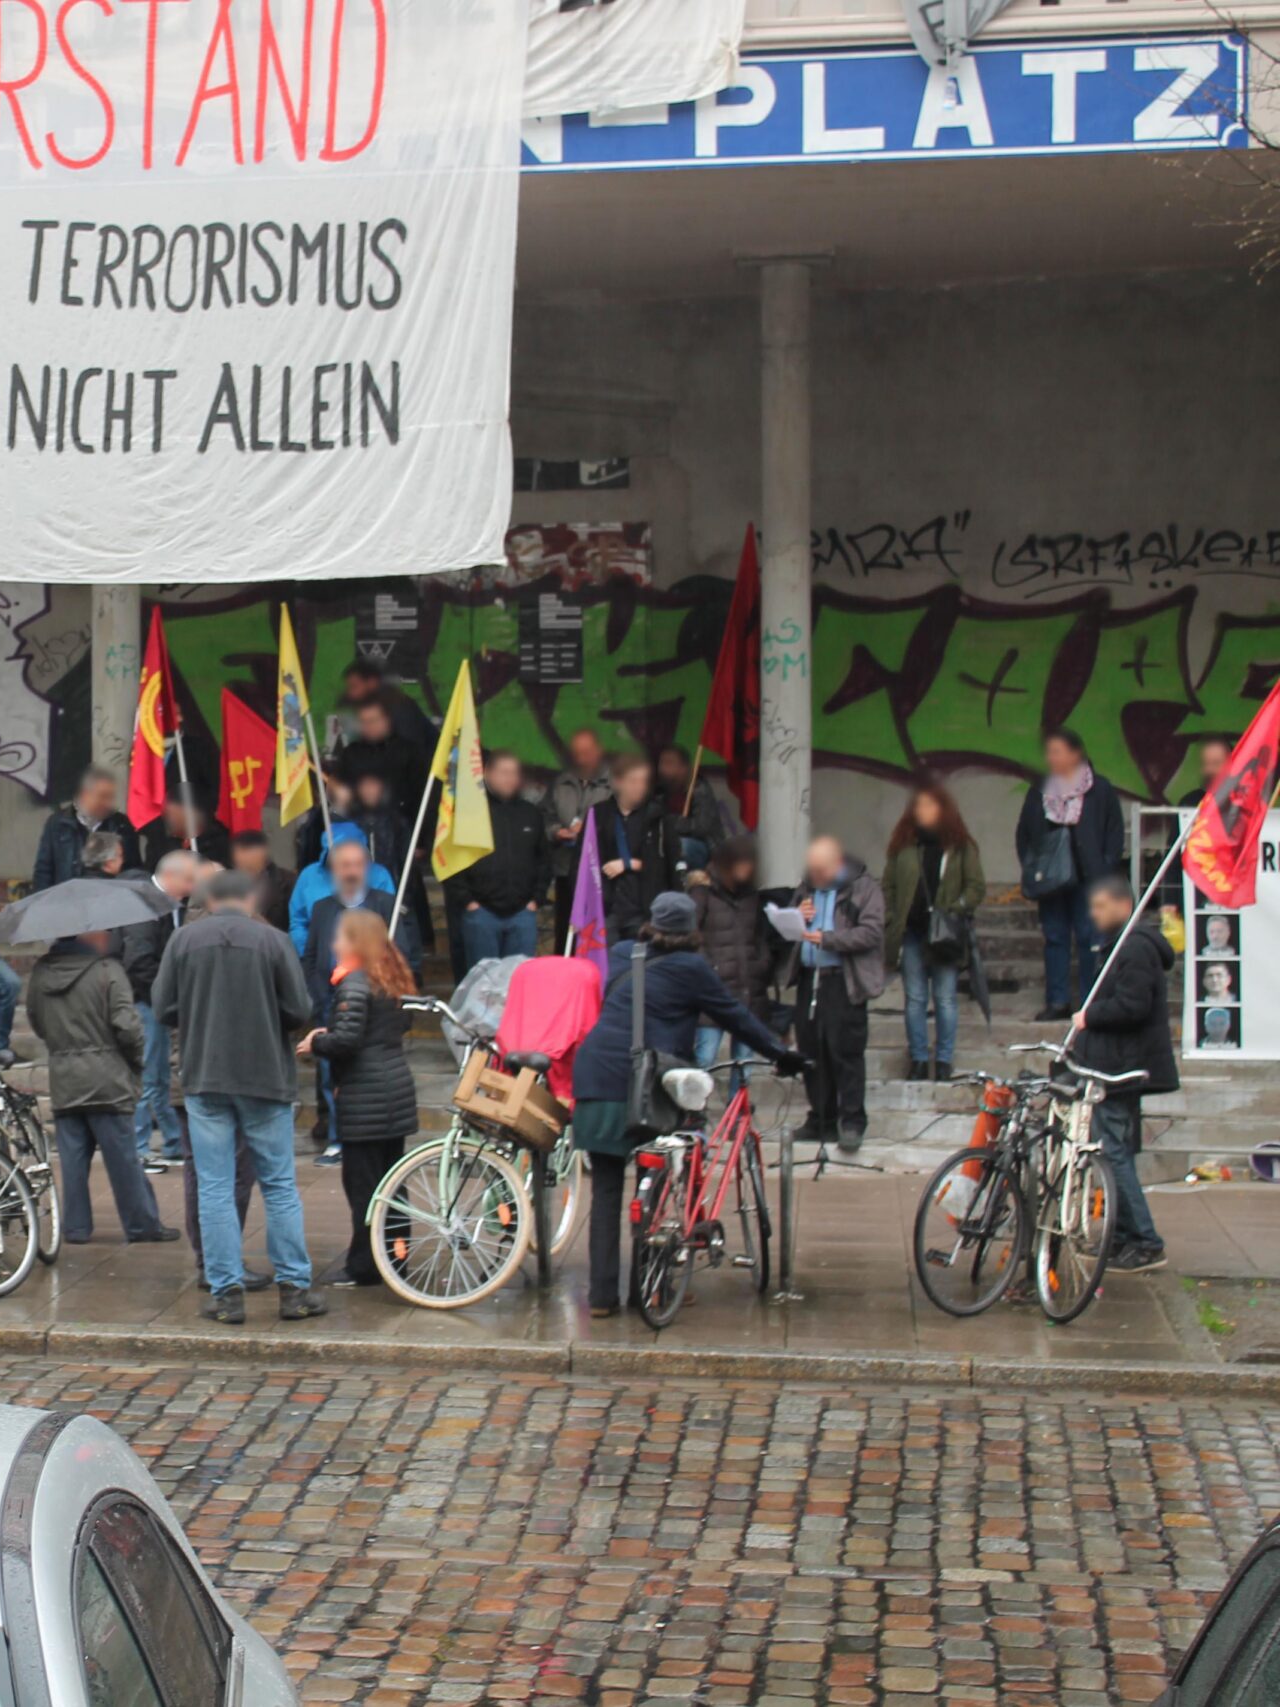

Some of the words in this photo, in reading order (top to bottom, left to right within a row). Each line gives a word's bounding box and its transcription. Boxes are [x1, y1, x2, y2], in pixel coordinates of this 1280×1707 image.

[21, 217, 407, 312] TERRORISMUS
[7, 363, 178, 453] NICHT
[197, 361, 401, 453] ALLEIN
